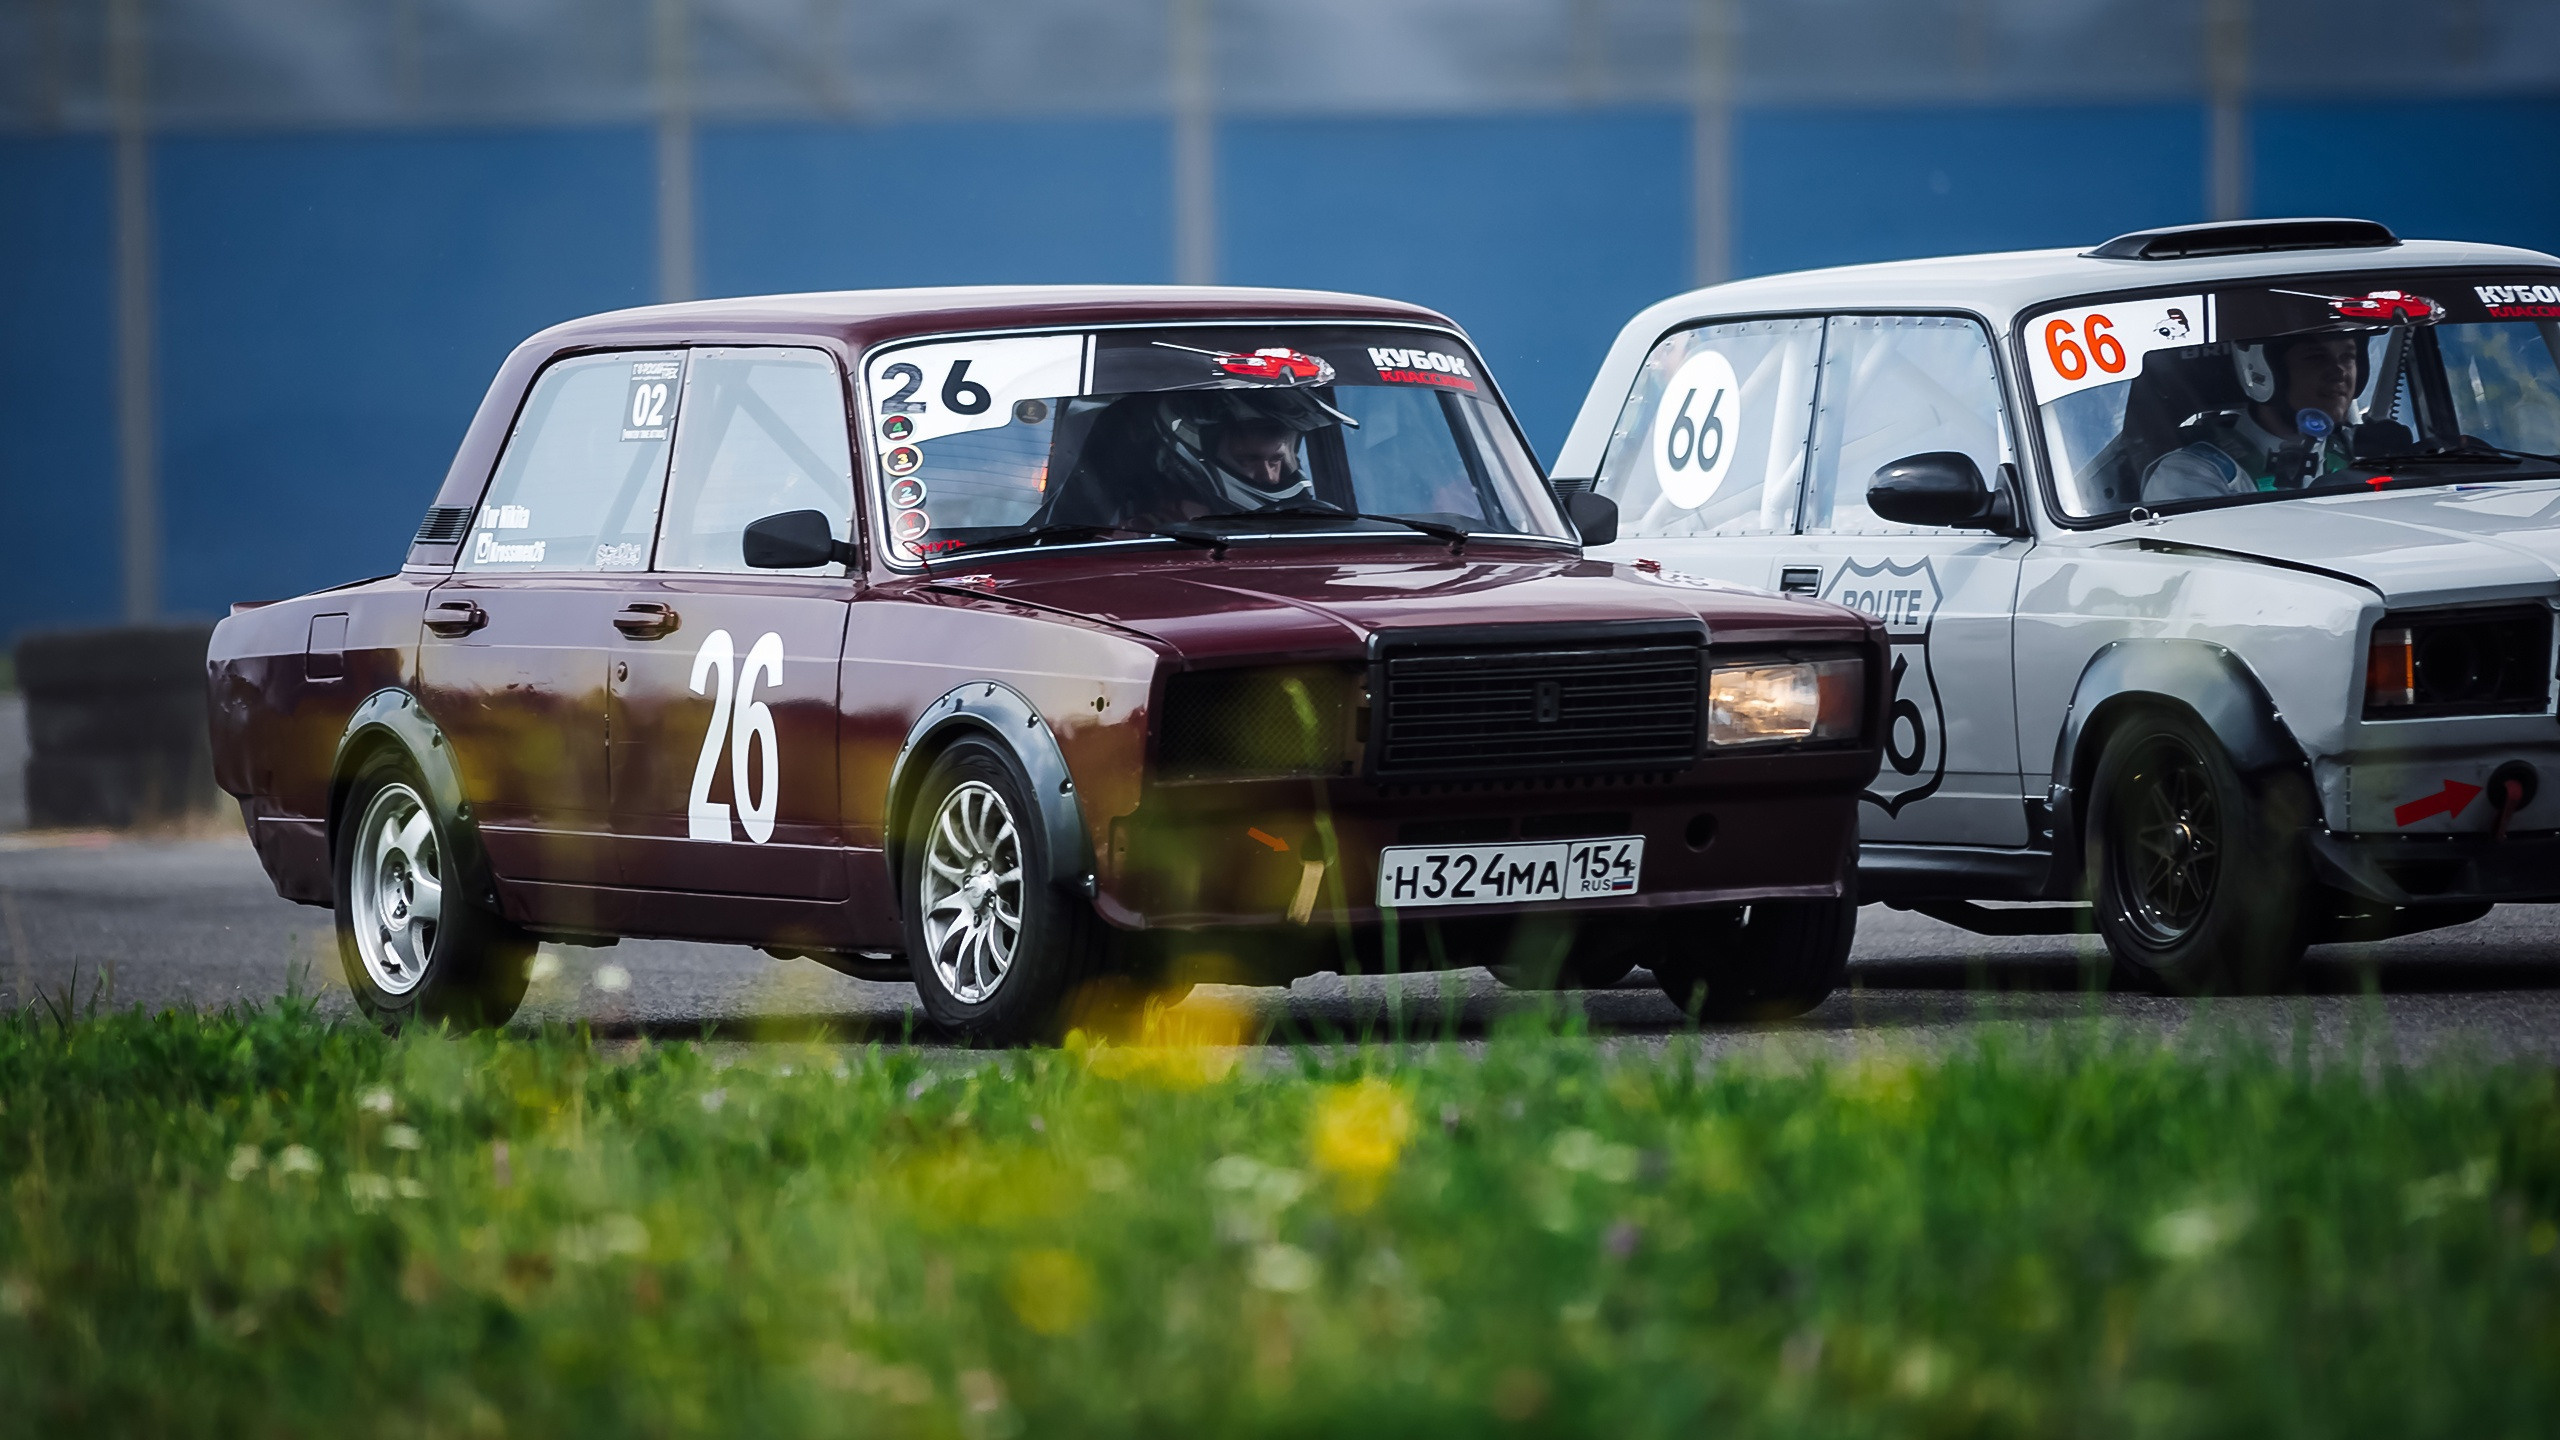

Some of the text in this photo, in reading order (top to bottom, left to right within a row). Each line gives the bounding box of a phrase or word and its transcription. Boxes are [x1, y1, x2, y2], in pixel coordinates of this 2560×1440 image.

[1366, 347, 1472, 378] КУБОК
[2044, 313, 2127, 381] 66
[632, 383, 668, 427] 02
[881, 359, 992, 416] 26
[892, 422, 904, 433] 4
[1667, 388, 1725, 473] 66
[897, 453, 909, 465] 3
[901, 486, 913, 498] 2
[1842, 589, 1923, 626] ROUTE
[688, 628, 785, 845] 26
[1394, 844, 1637, 900] Н324МА 154
[1580, 877, 1612, 892] RUS
